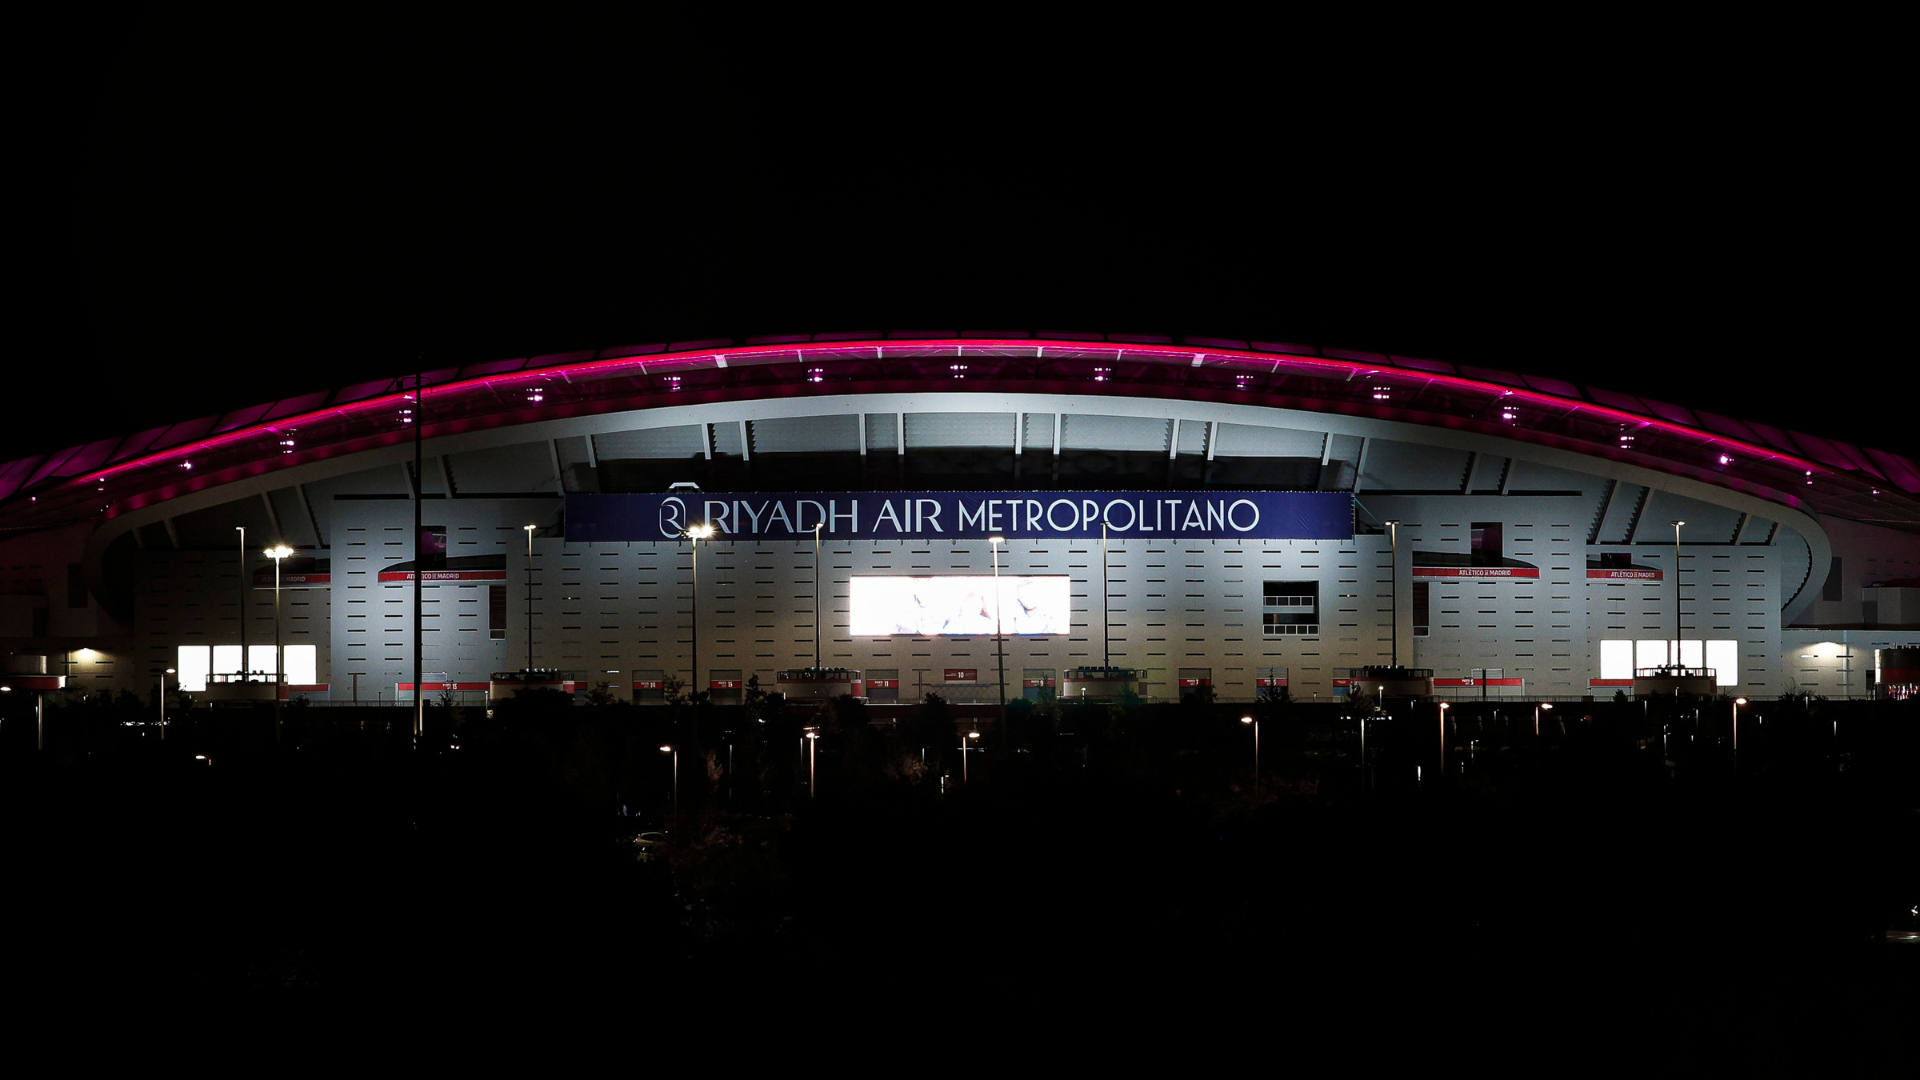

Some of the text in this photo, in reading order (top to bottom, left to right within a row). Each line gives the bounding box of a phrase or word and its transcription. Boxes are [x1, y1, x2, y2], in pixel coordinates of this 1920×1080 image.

[704, 500, 857, 533] RIYADH
[873, 499, 944, 533] AIR
[958, 499, 1260, 532] METROPOLITANO
[1610, 570, 1633, 578] ATLÉTICO
